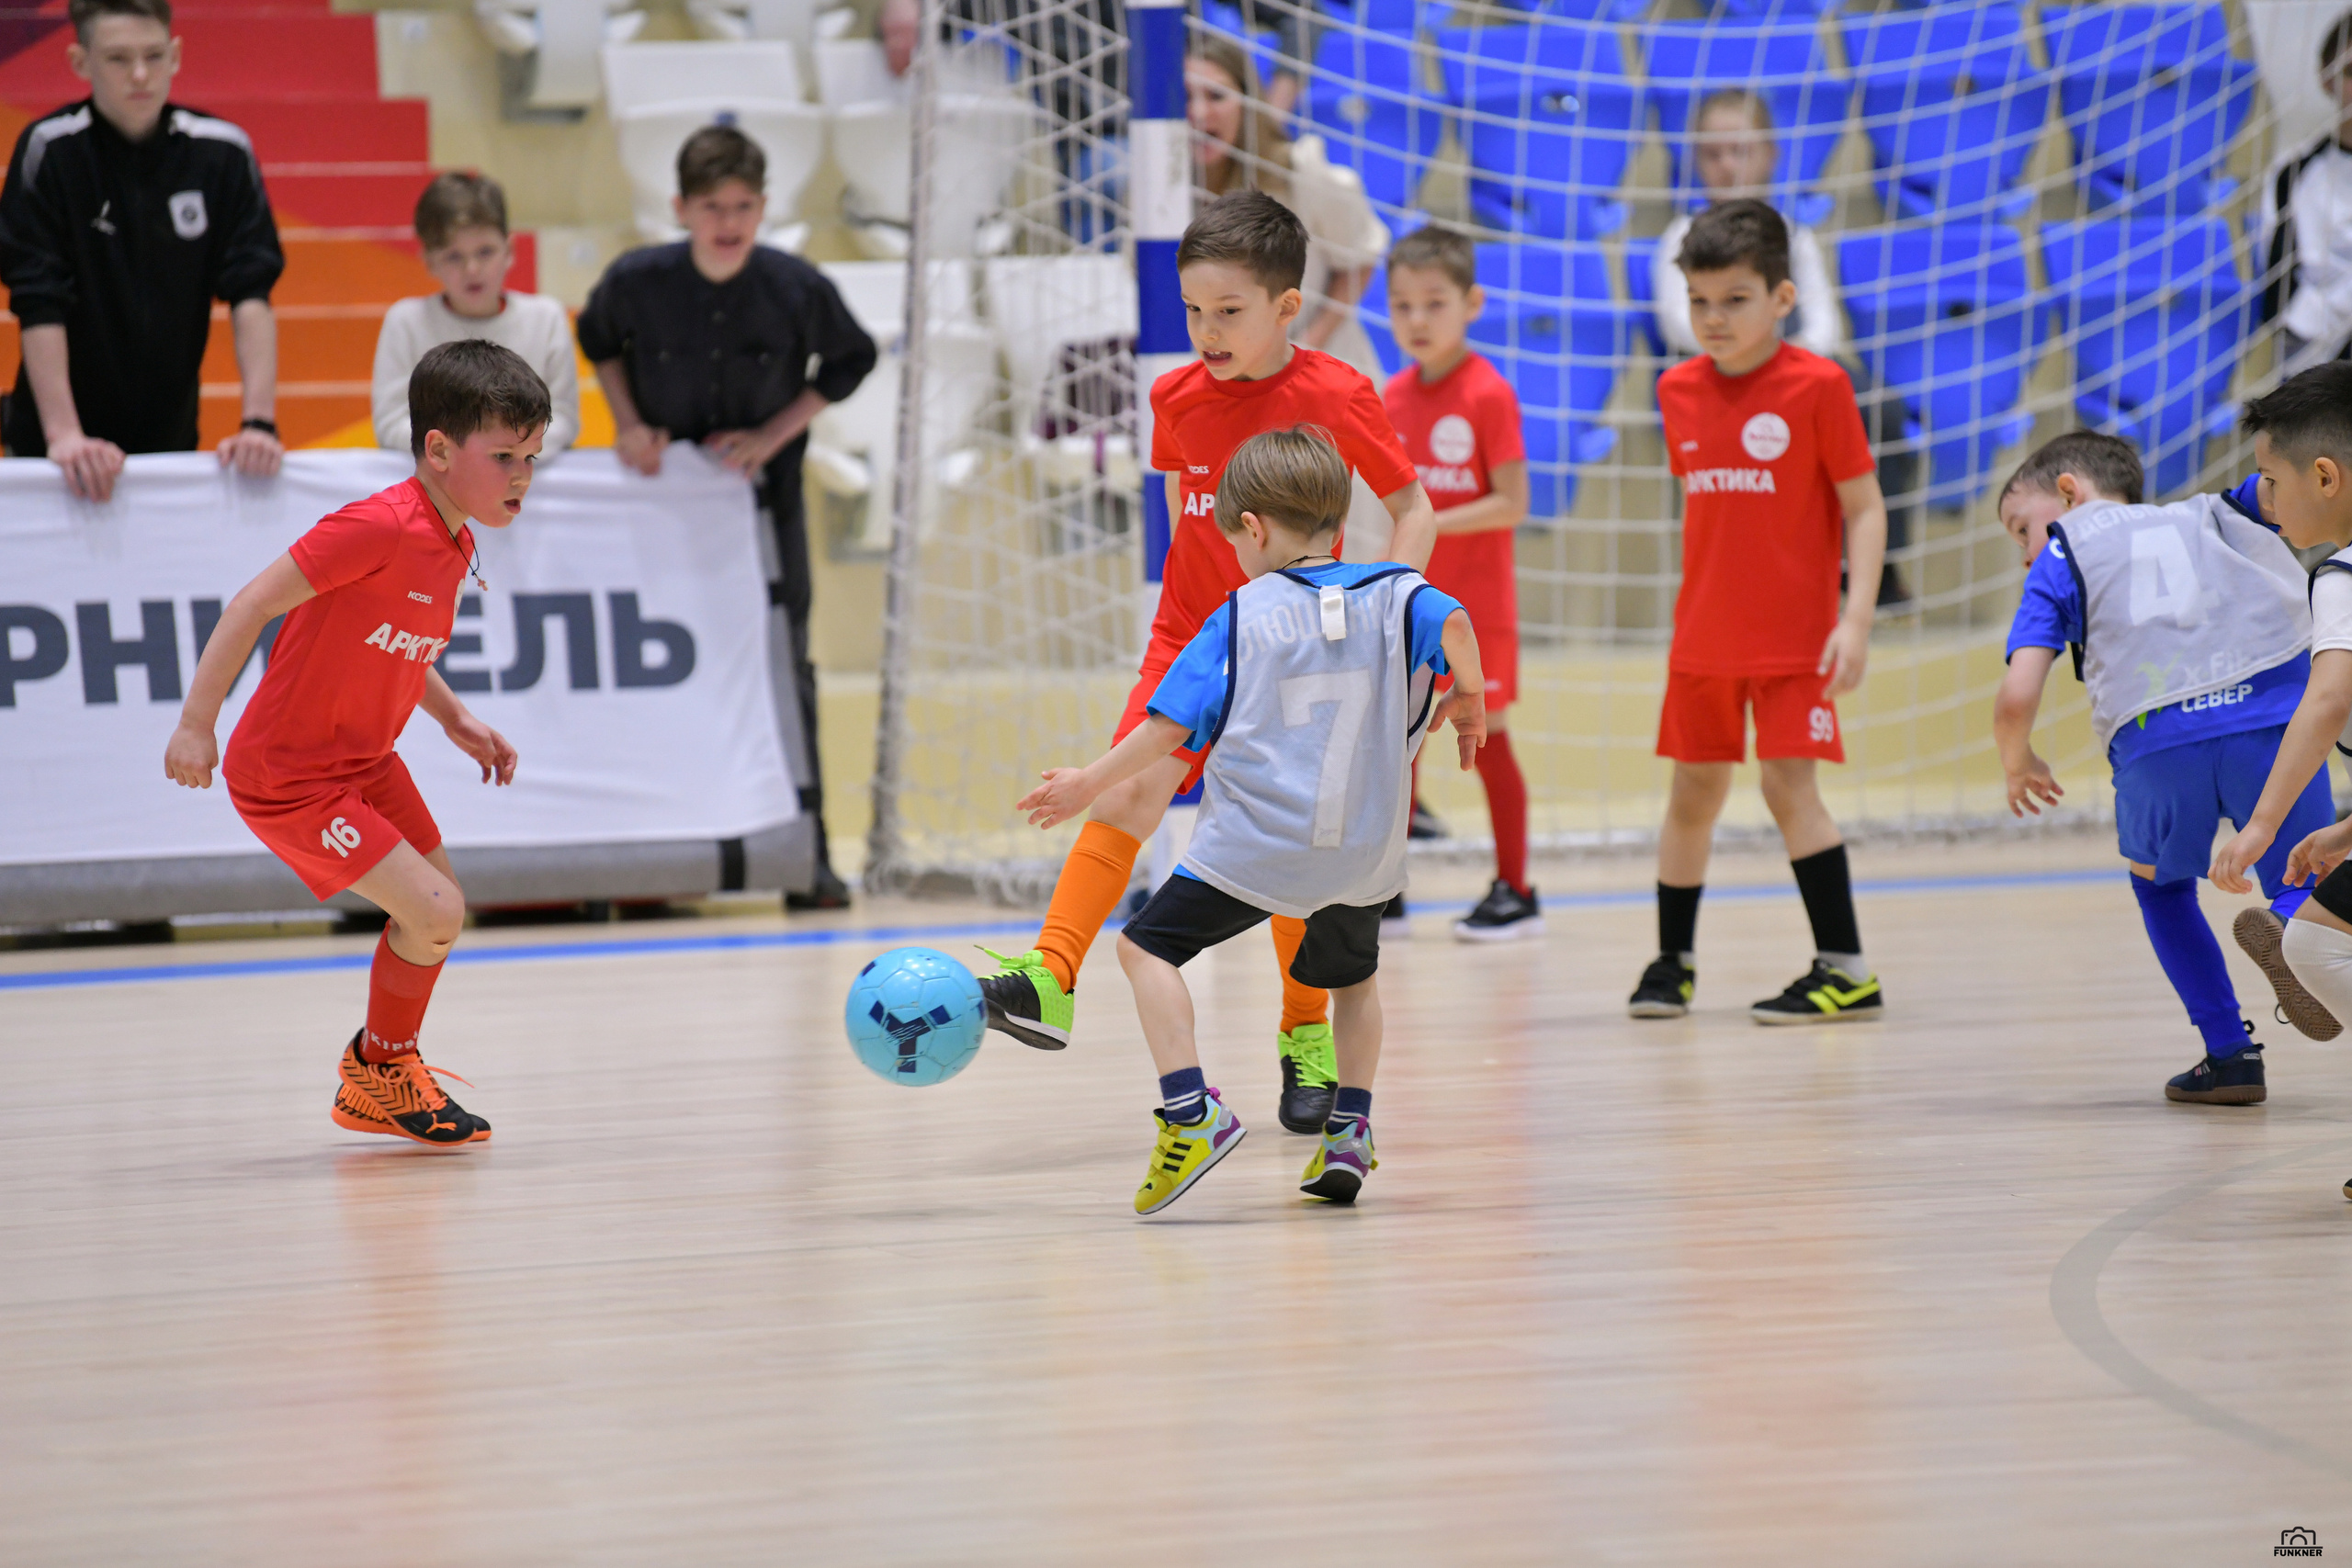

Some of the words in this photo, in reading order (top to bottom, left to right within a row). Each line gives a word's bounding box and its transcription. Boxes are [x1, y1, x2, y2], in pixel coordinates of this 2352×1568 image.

[2130, 524, 2221, 628] 4
[1278, 669, 1372, 848] 7
[321, 817, 361, 858] 16
